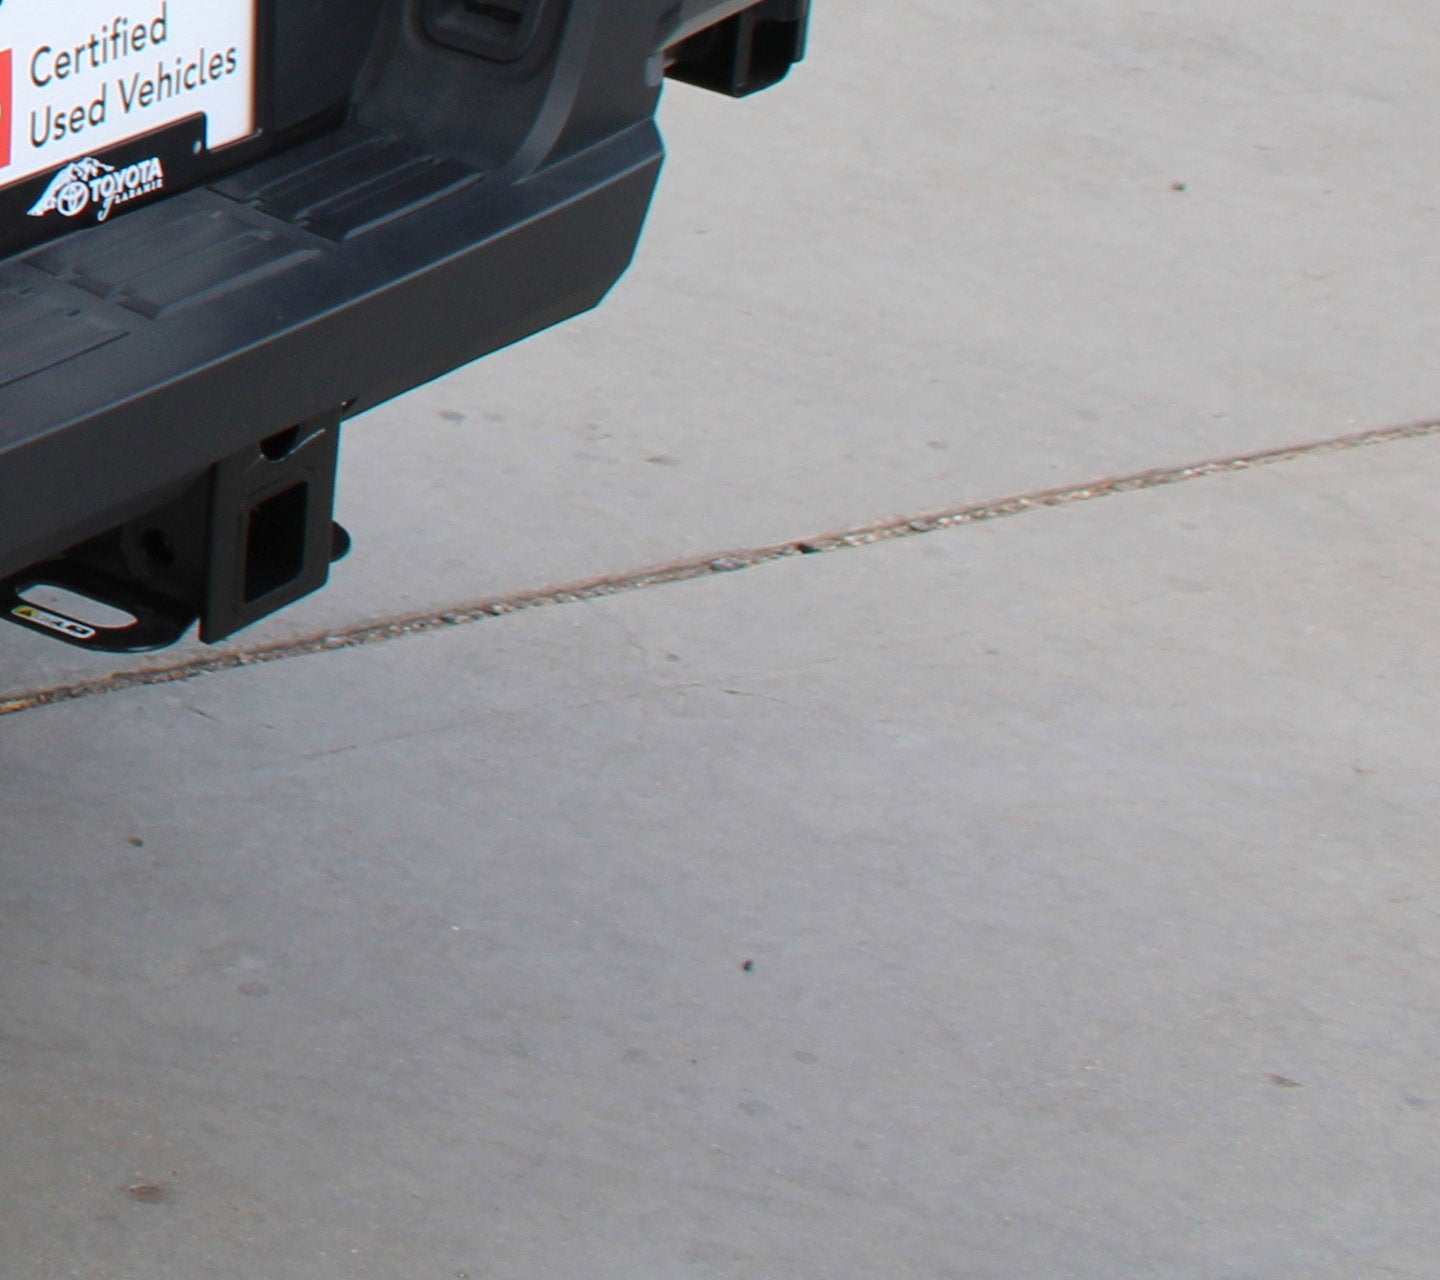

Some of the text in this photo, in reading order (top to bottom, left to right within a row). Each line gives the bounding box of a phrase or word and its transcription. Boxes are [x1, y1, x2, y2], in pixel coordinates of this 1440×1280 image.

[30, 0, 167, 88] Certified
[30, 46, 237, 148] Used Vehicles
[88, 157, 163, 202] TOYOTA
[114, 178, 163, 204] LARAMIE
